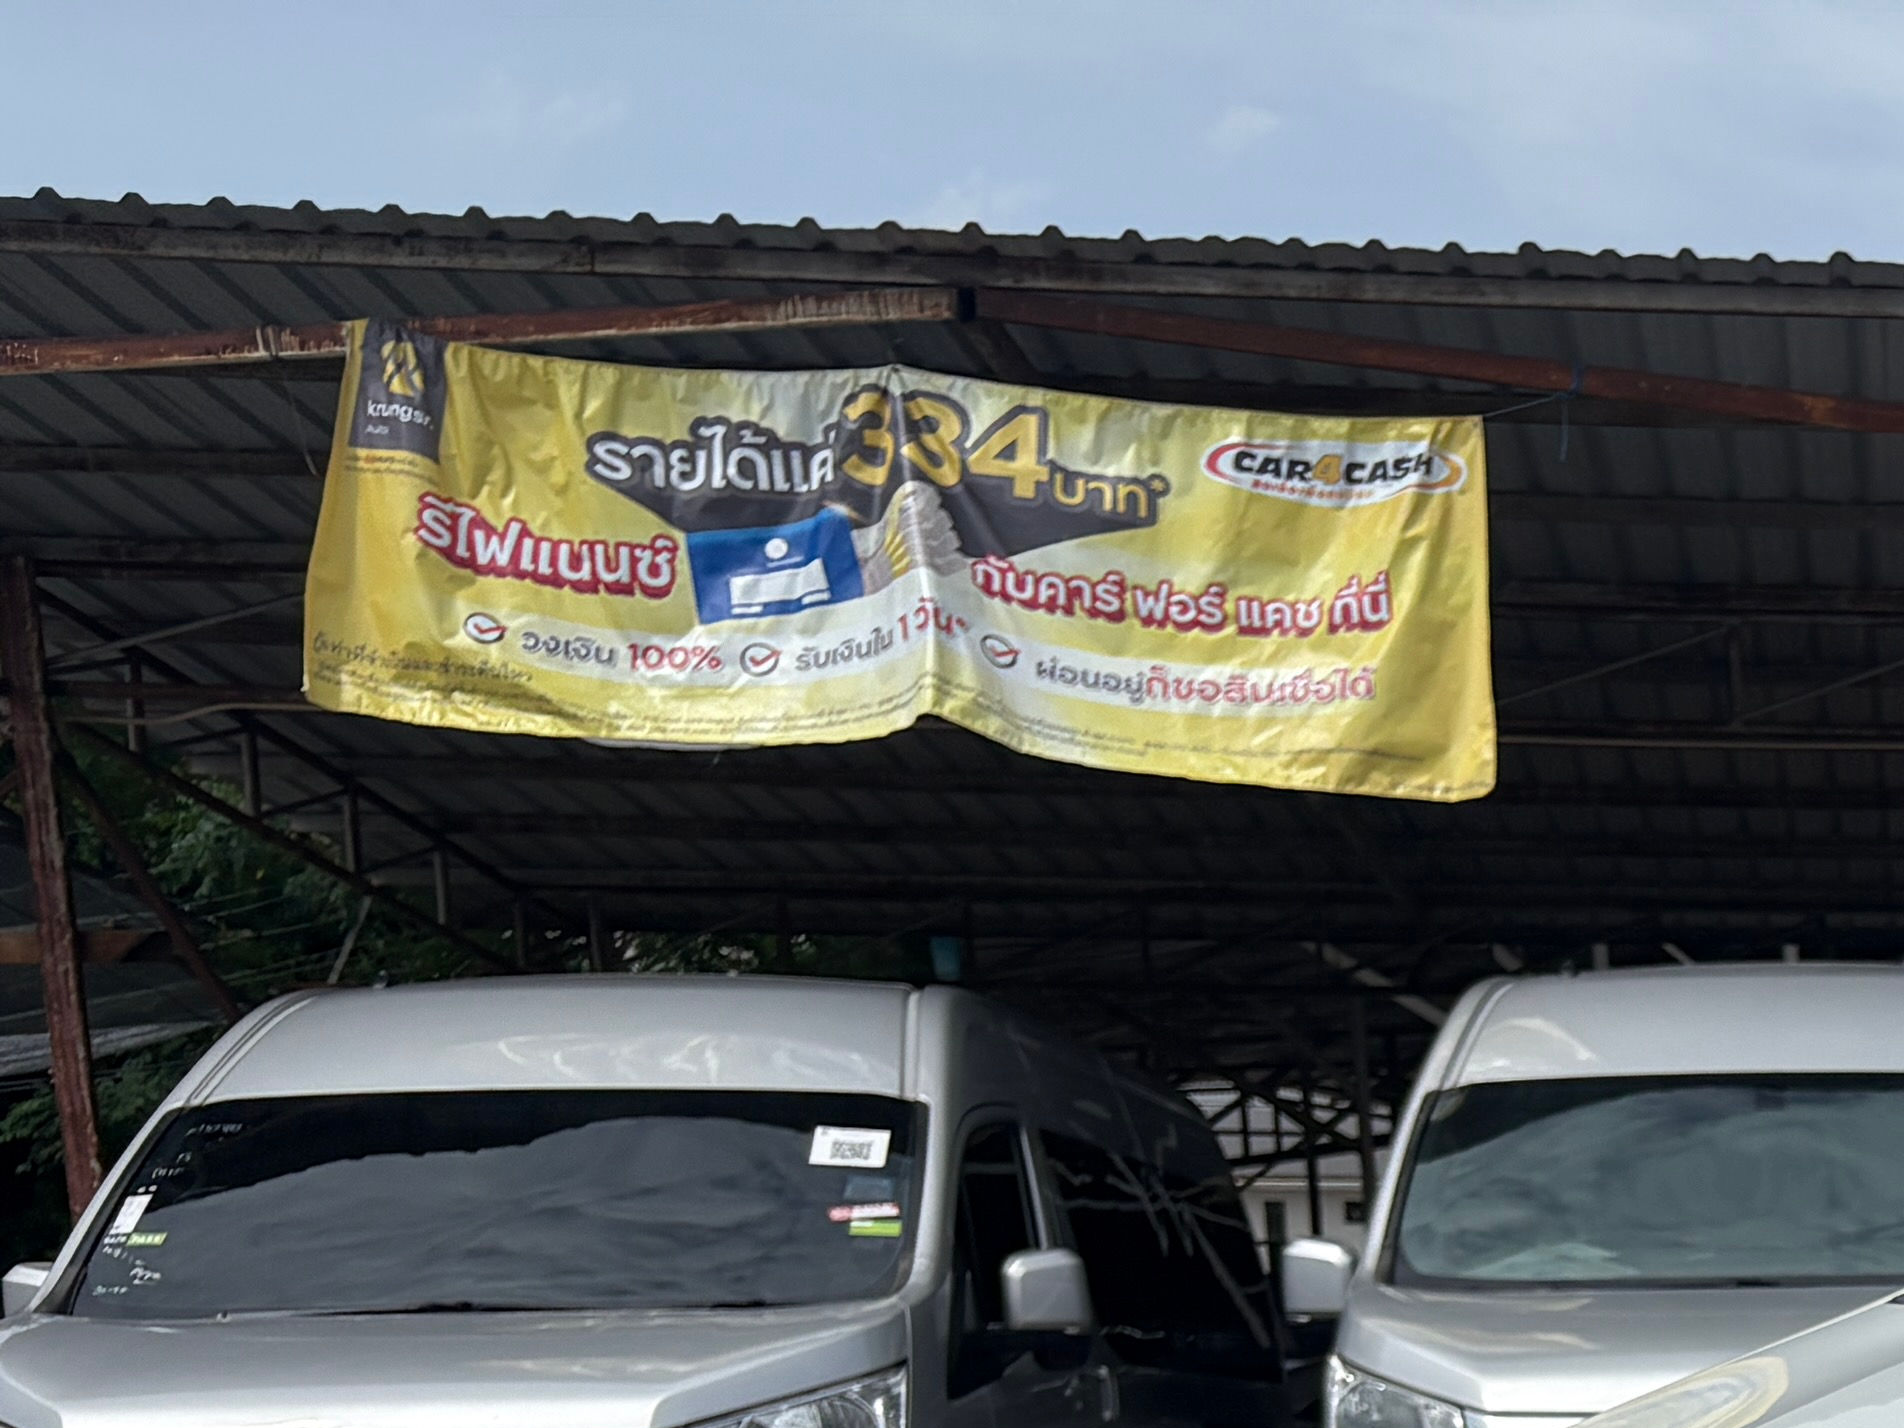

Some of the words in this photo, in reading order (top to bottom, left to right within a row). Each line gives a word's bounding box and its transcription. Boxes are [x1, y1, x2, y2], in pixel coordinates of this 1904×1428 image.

[592, 424, 838, 494] รายได้แค่
[841, 388, 1050, 501] 334
[1233, 449, 1435, 486] CAR4CASH
[416, 493, 677, 590] รีไฟแนนซ์
[521, 631, 620, 668] วงเงิน
[627, 643, 725, 673] 100%
